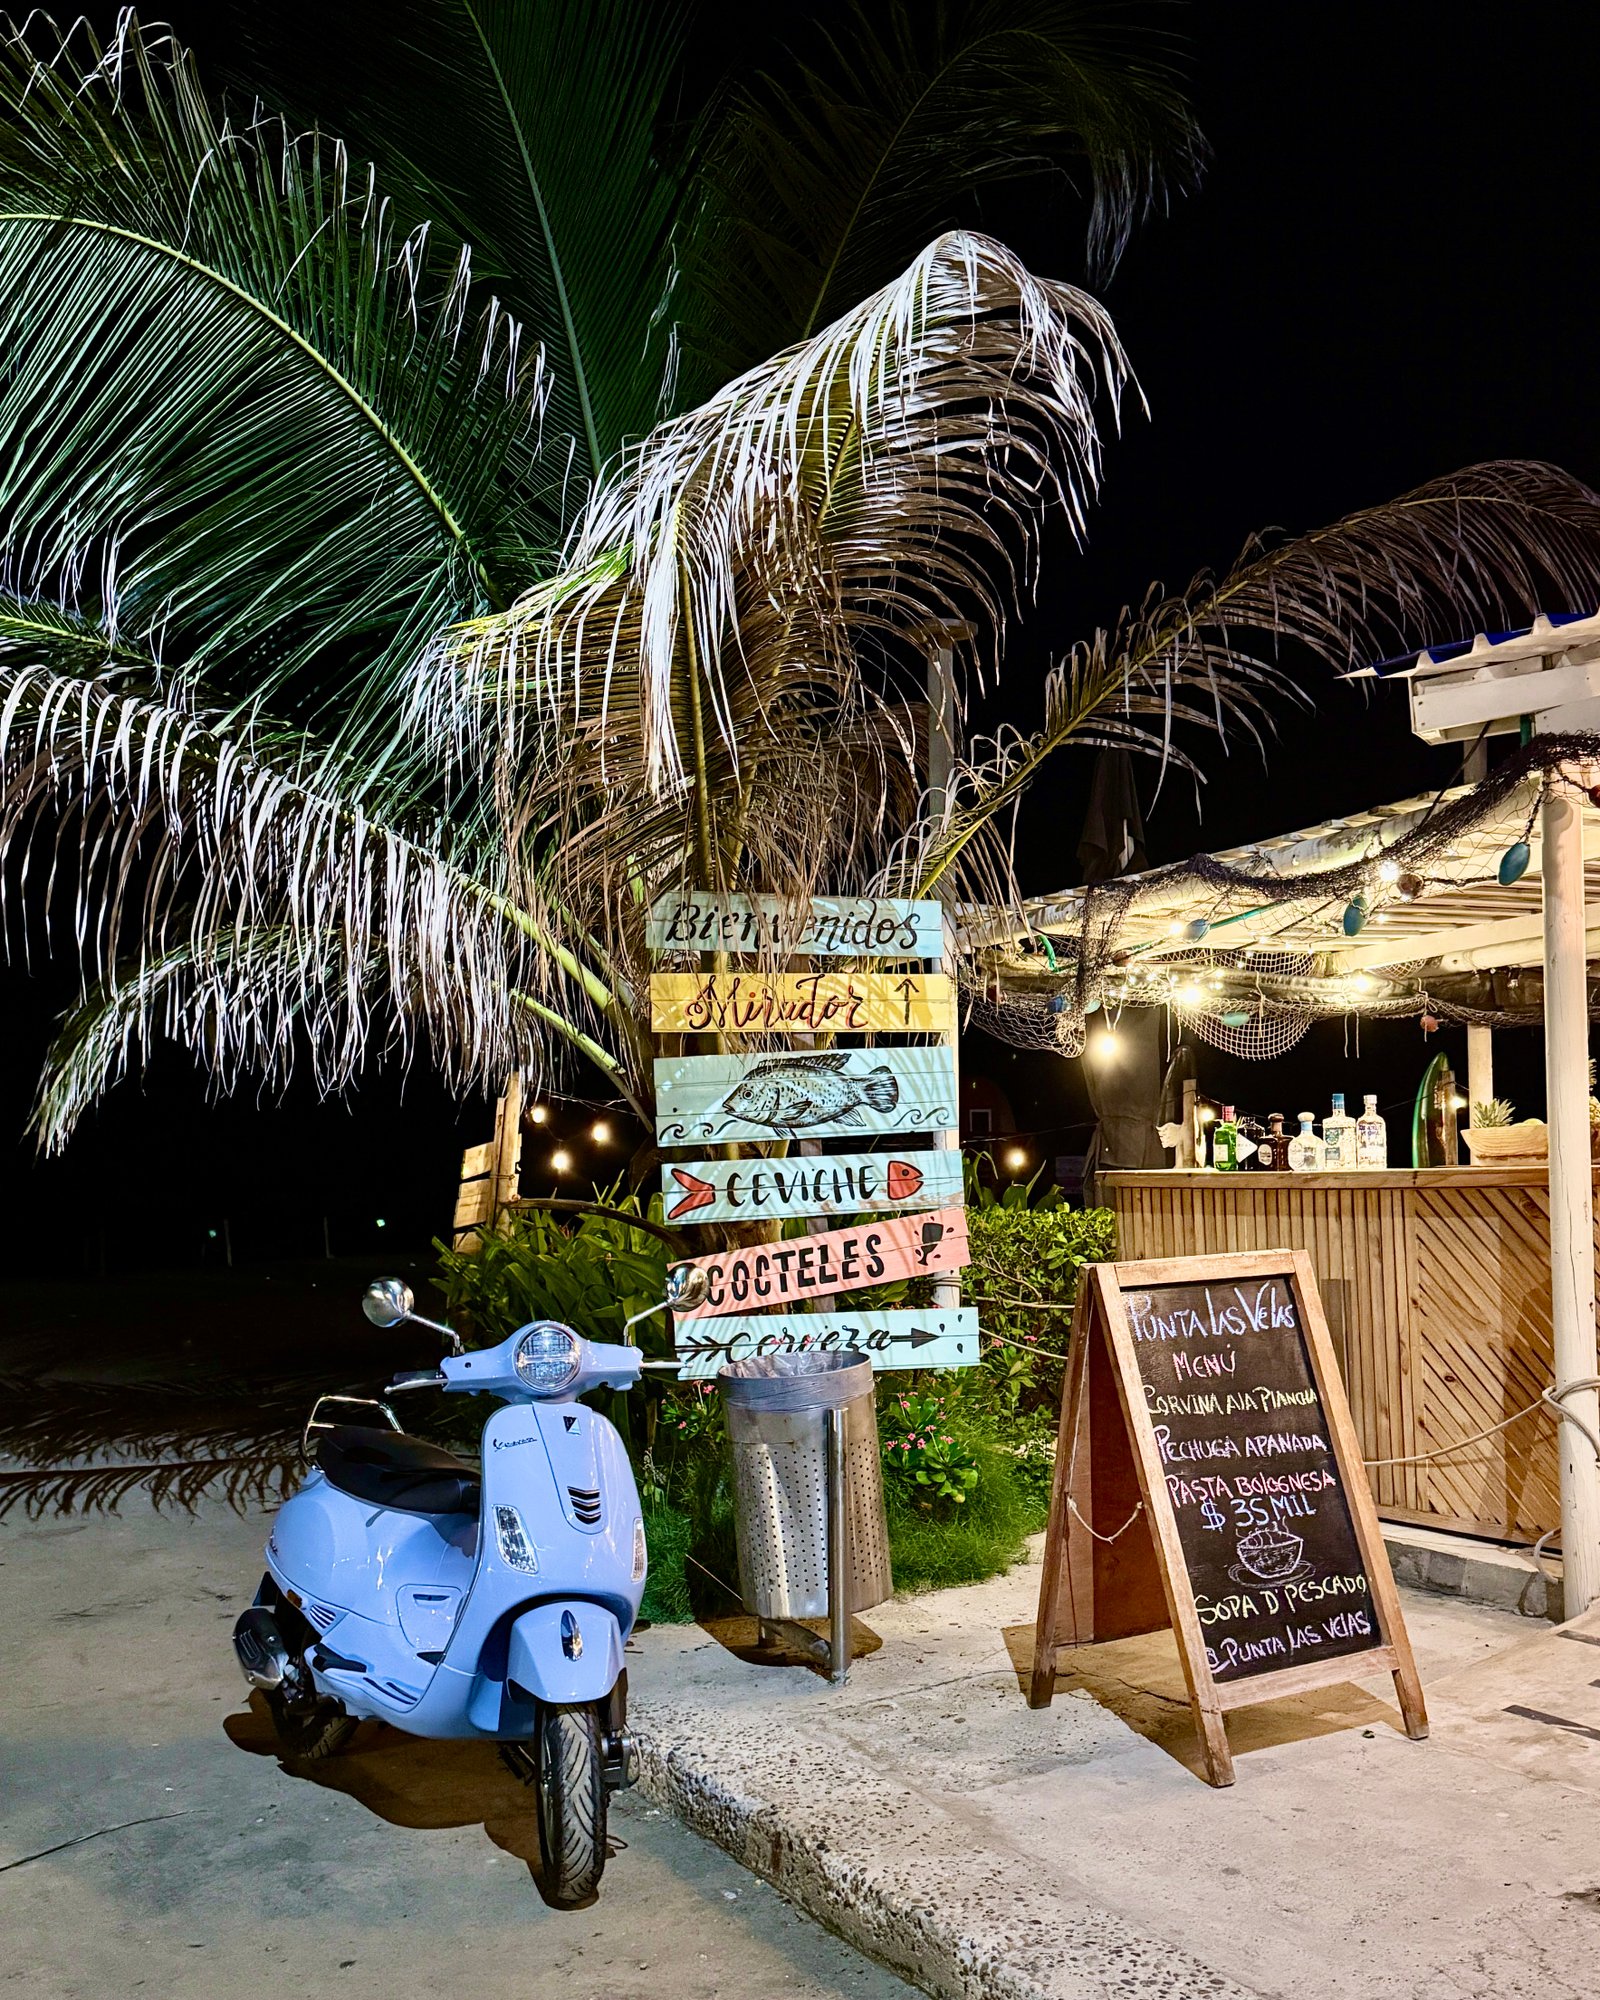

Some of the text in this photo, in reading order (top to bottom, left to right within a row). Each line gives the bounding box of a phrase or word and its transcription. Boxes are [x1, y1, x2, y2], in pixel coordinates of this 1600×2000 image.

[685, 974, 869, 1030] Mirador
[726, 1165, 879, 1208] CEVICHE
[706, 1234, 885, 1307] COCTELES
[1143, 1384, 1225, 1416] CORVINA
[1153, 1424, 1328, 1464] PECHUGA APANADA
[1165, 1474, 1234, 1508] PASTA
[1269, 1492, 1317, 1521] MIL
[1193, 1594, 1260, 1625] SOPA
[1284, 1574, 1367, 1613] PESCADO
